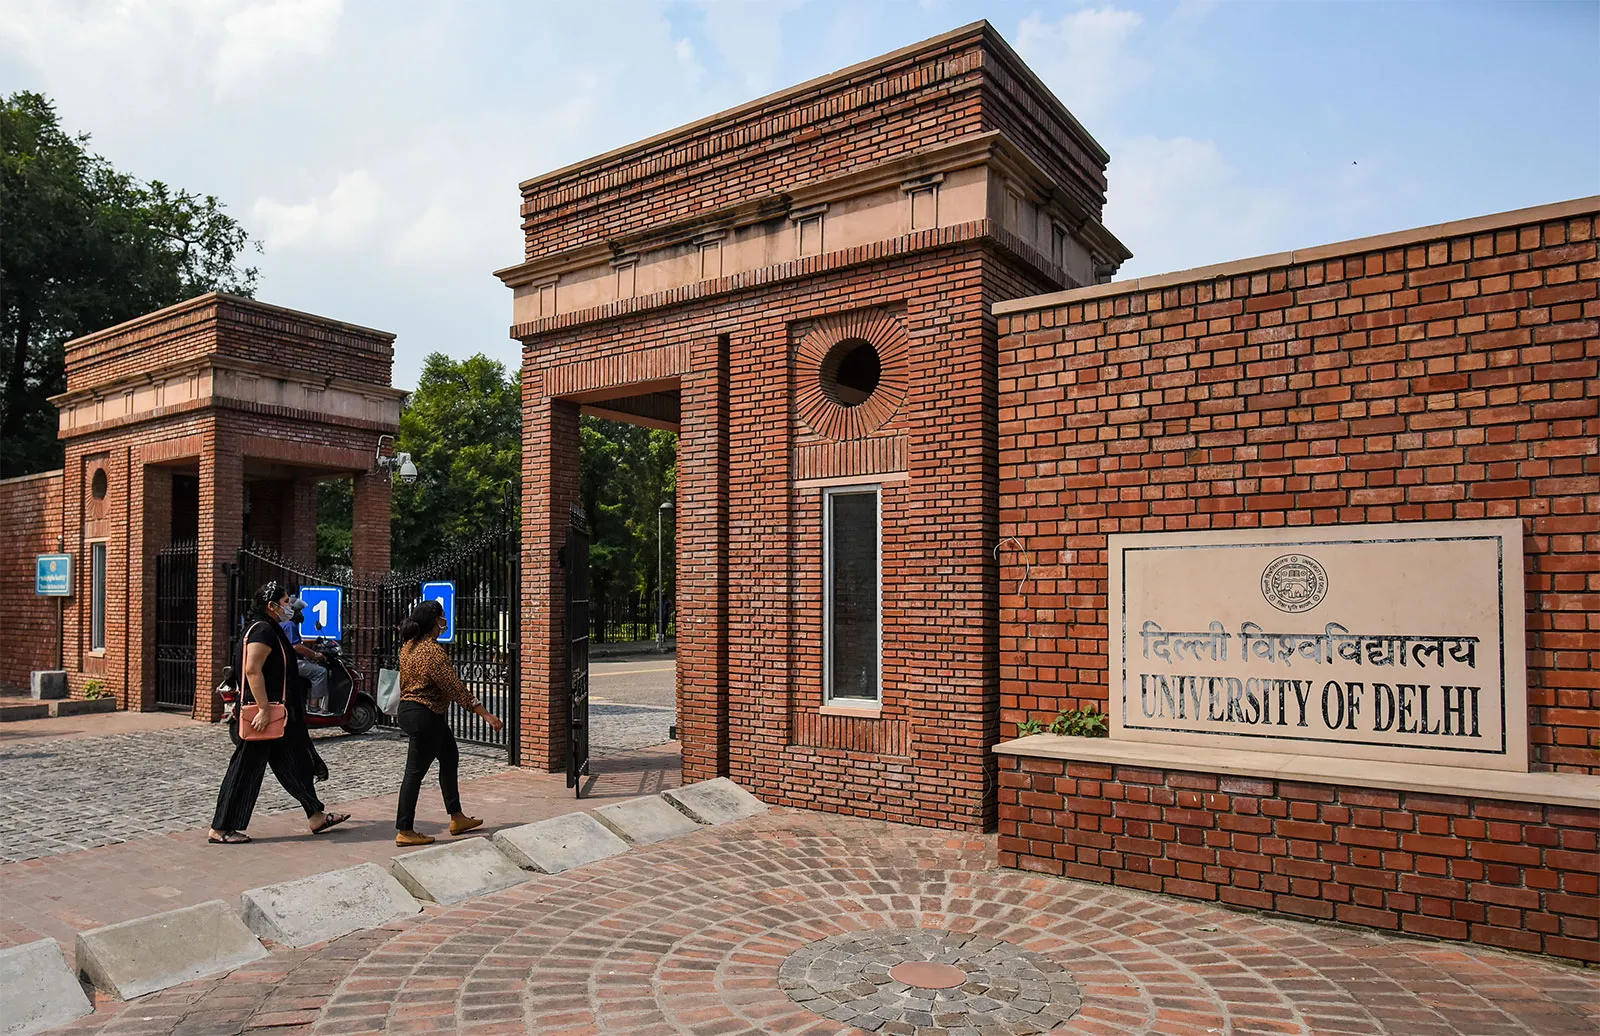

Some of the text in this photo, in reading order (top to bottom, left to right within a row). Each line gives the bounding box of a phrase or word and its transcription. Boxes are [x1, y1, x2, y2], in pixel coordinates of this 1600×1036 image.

[312, 599, 328, 627] 1
[1139, 620, 1481, 669] दिल्ली विश्वविद्यालय
[1139, 673, 1482, 738] UNIVERSITY OF DELHI
